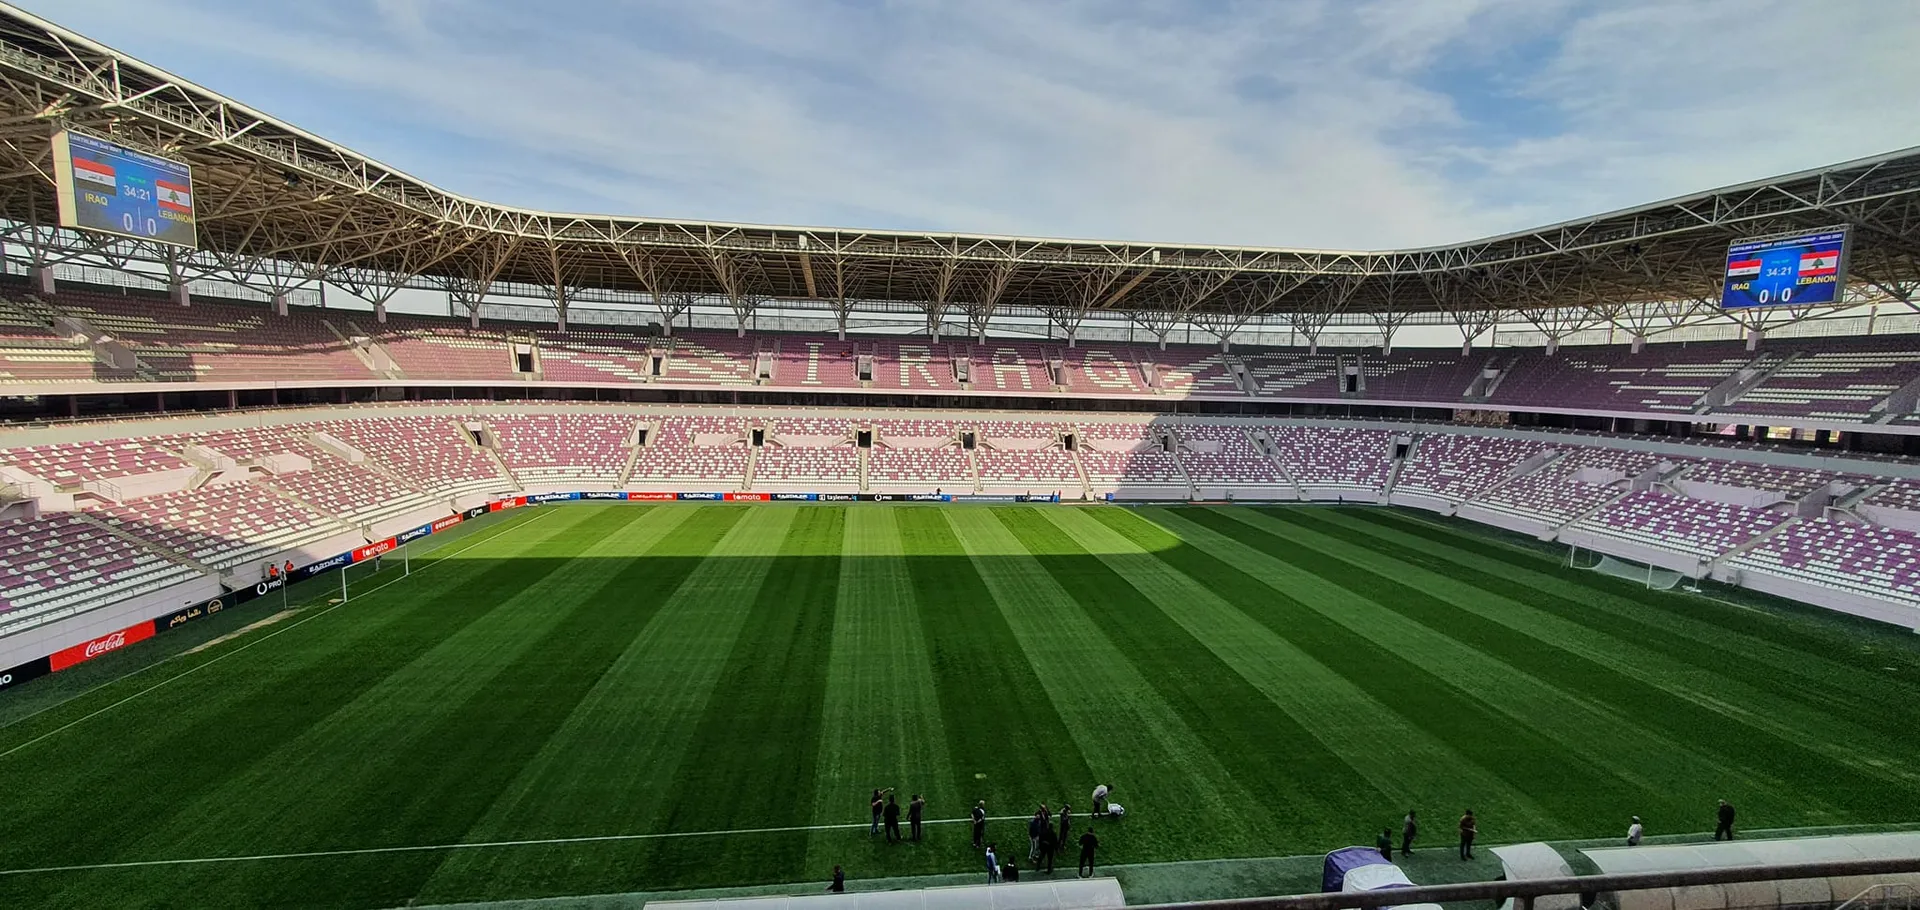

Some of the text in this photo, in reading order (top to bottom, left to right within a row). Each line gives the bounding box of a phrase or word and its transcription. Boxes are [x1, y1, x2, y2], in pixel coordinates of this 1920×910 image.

[85, 192, 108, 206] IRAQ
[123, 185, 151, 200] 34:21
[158, 209, 194, 224] LEBANON
[123, 212, 157, 236] 0 0
[1766, 266, 1792, 277] 34:21
[1731, 283, 1750, 291] IRAQ
[1796, 275, 1837, 285] LEBANON
[1759, 287, 1791, 303] 0 0
[800, 342, 1140, 392] IRAQ
[269, 580, 281, 589] PRO
